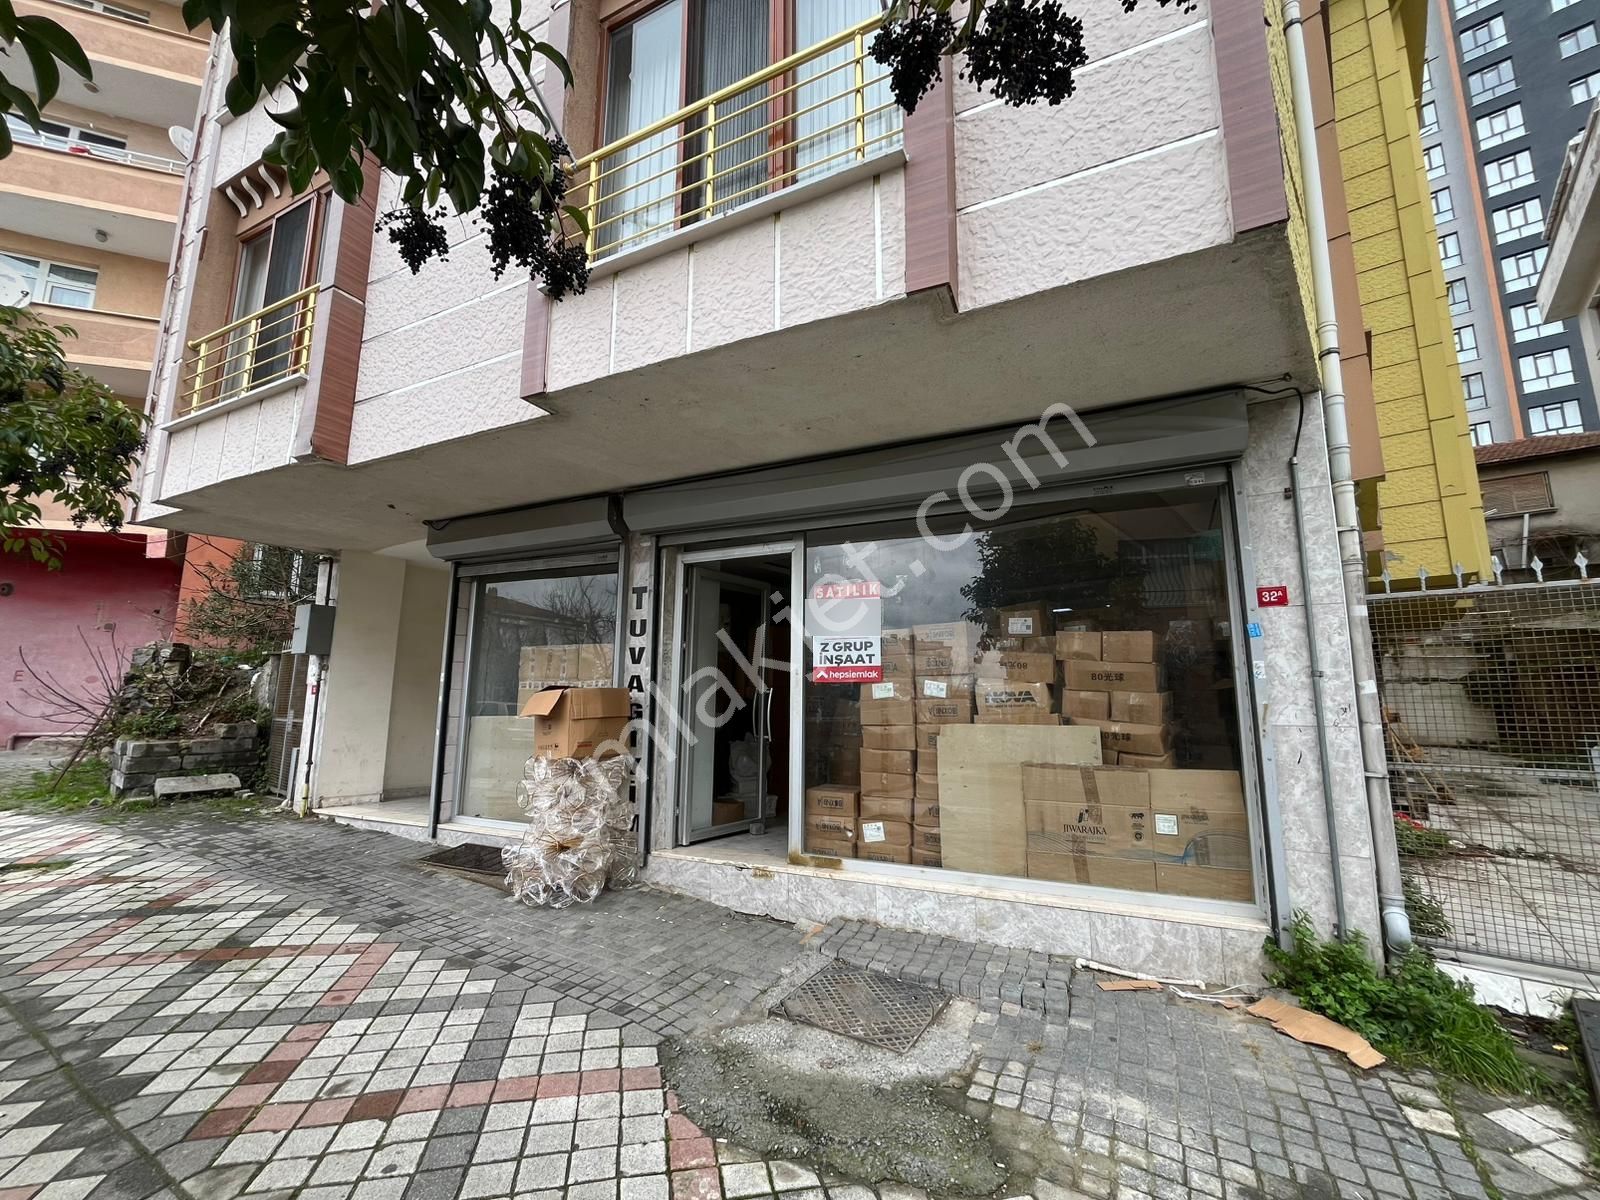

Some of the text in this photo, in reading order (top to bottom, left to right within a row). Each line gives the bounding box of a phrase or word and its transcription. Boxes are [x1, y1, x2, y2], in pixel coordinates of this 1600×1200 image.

[817, 583, 878, 599] SATILIK
[820, 641, 874, 653] Z GRUP
[819, 652, 876, 667] İNŞAAT
[829, 670, 879, 680] hepsiemlak
